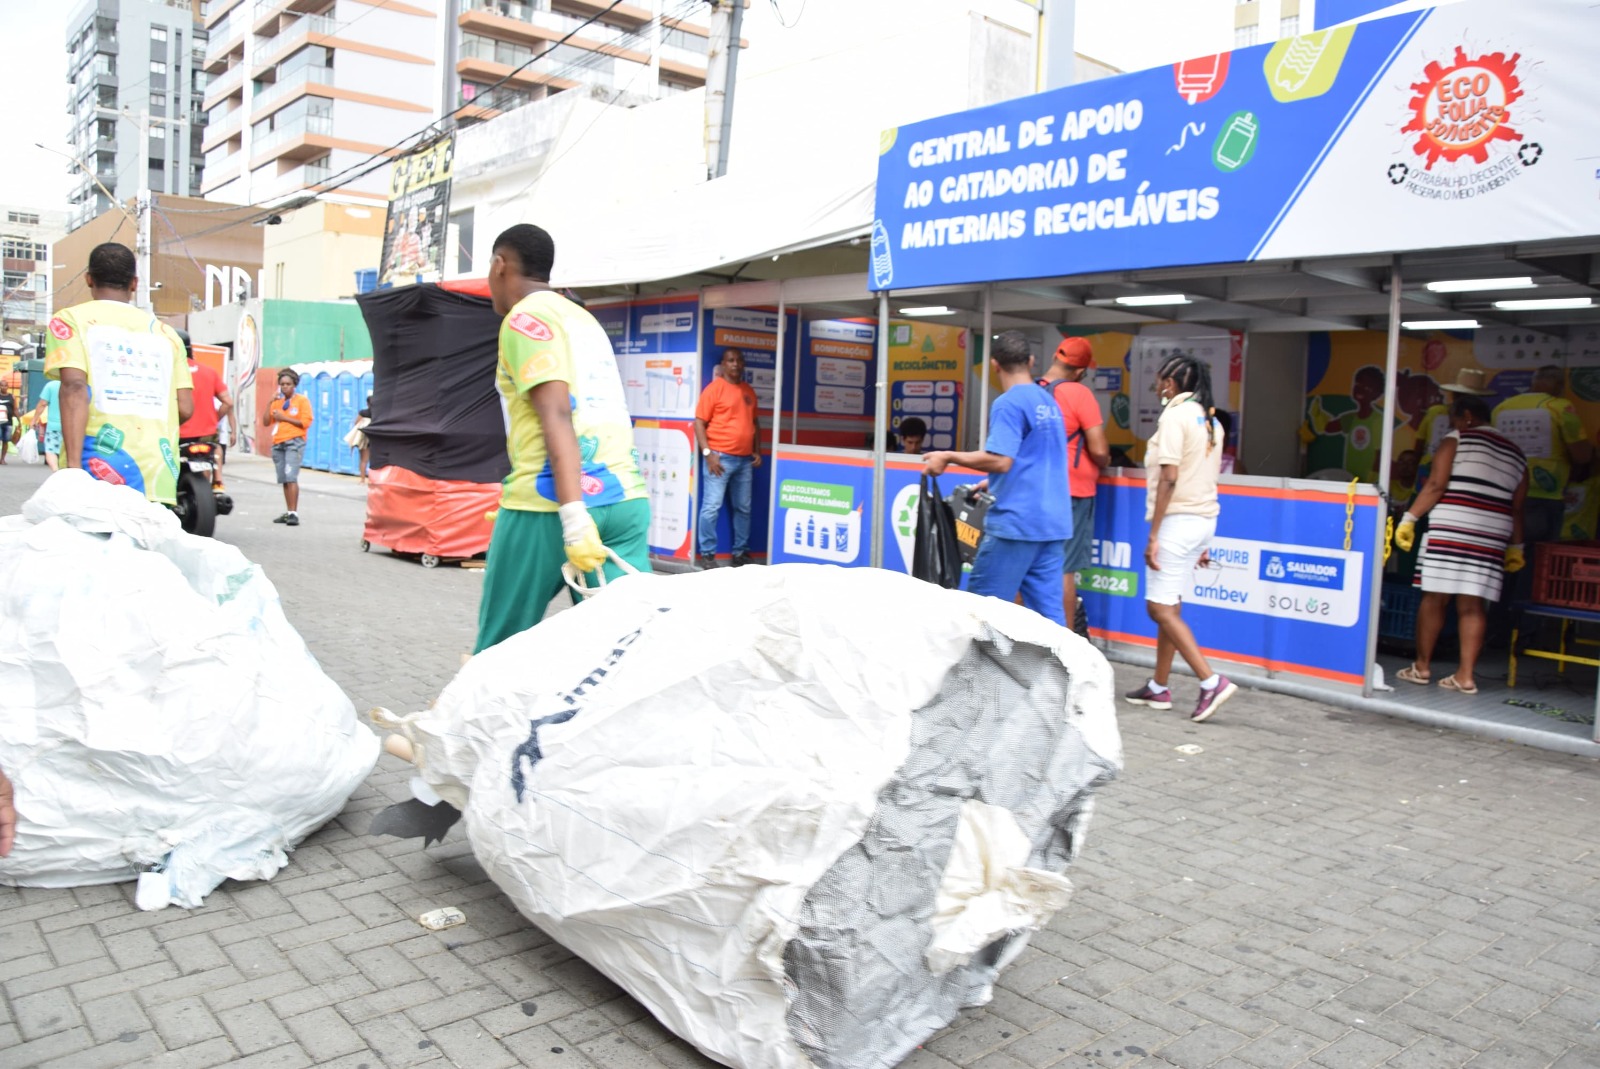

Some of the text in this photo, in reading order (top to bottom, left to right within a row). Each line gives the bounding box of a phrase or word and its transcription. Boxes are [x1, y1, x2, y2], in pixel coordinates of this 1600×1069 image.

[1437, 72, 1491, 102] ECO
[1438, 97, 1488, 122] FOLIA
[908, 99, 1144, 169] CENTRAL DE APOIO
[903, 148, 1128, 209] AO CATADOR(A) DE
[1404, 165, 1522, 201] PRESERVA O MEIO AMBIENTE
[1419, 169, 1468, 188] TRABALHO
[1470, 155, 1515, 185] DECENTE
[901, 180, 1220, 250] MATERIAIS RECICLÁVEIS
[893, 355, 958, 371] RECICLÔMETRO
[782, 484, 831, 498] AQUI COLETAMOS
[782, 493, 812, 504] PLÁSTICOS
[817, 497, 851, 509] ALUMÍNIOS
[1286, 561, 1338, 577] SALVADOR
[1091, 574, 1129, 593] 2024
[1193, 584, 1249, 603] ambev
